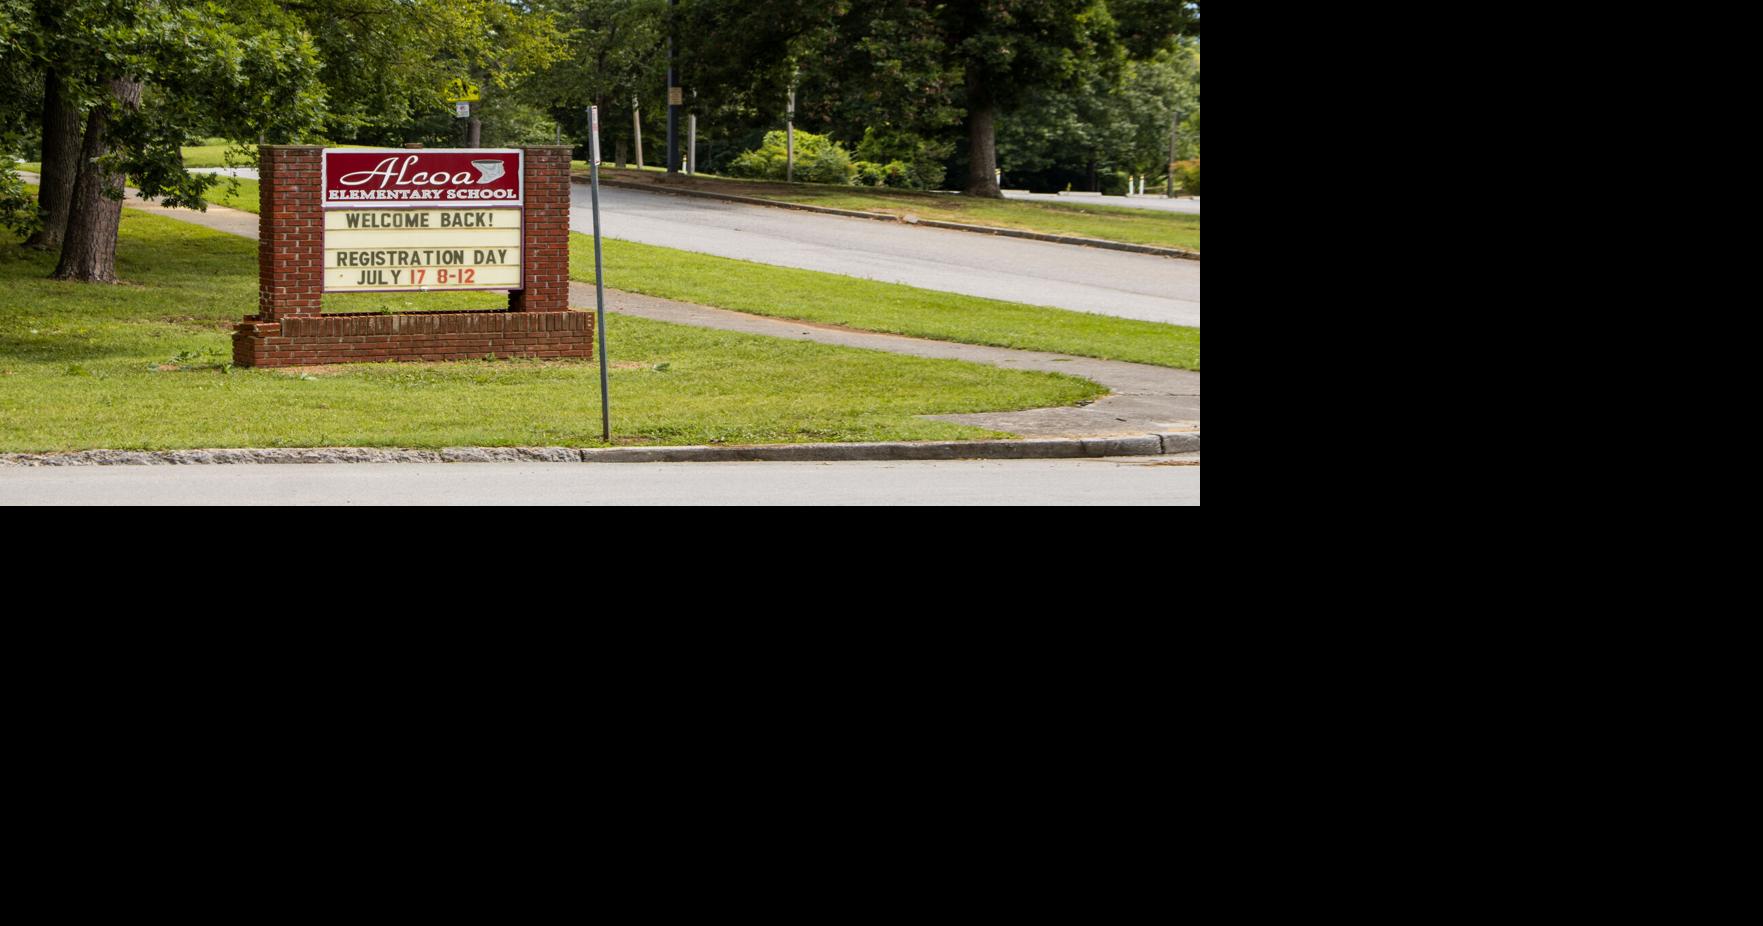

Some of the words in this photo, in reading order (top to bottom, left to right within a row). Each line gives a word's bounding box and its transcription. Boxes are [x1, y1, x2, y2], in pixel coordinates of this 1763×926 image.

[328, 189, 443, 200] ELEMENTARY
[447, 188, 517, 199] SCHOOL
[346, 212, 430, 228] WELCOME
[440, 212, 494, 228] BACK!
[336, 250, 464, 266] REGISTRATION
[473, 249, 508, 265] DAY
[356, 269, 402, 285] JULY
[410, 269, 426, 284] 17
[437, 268, 475, 284] 8-12
